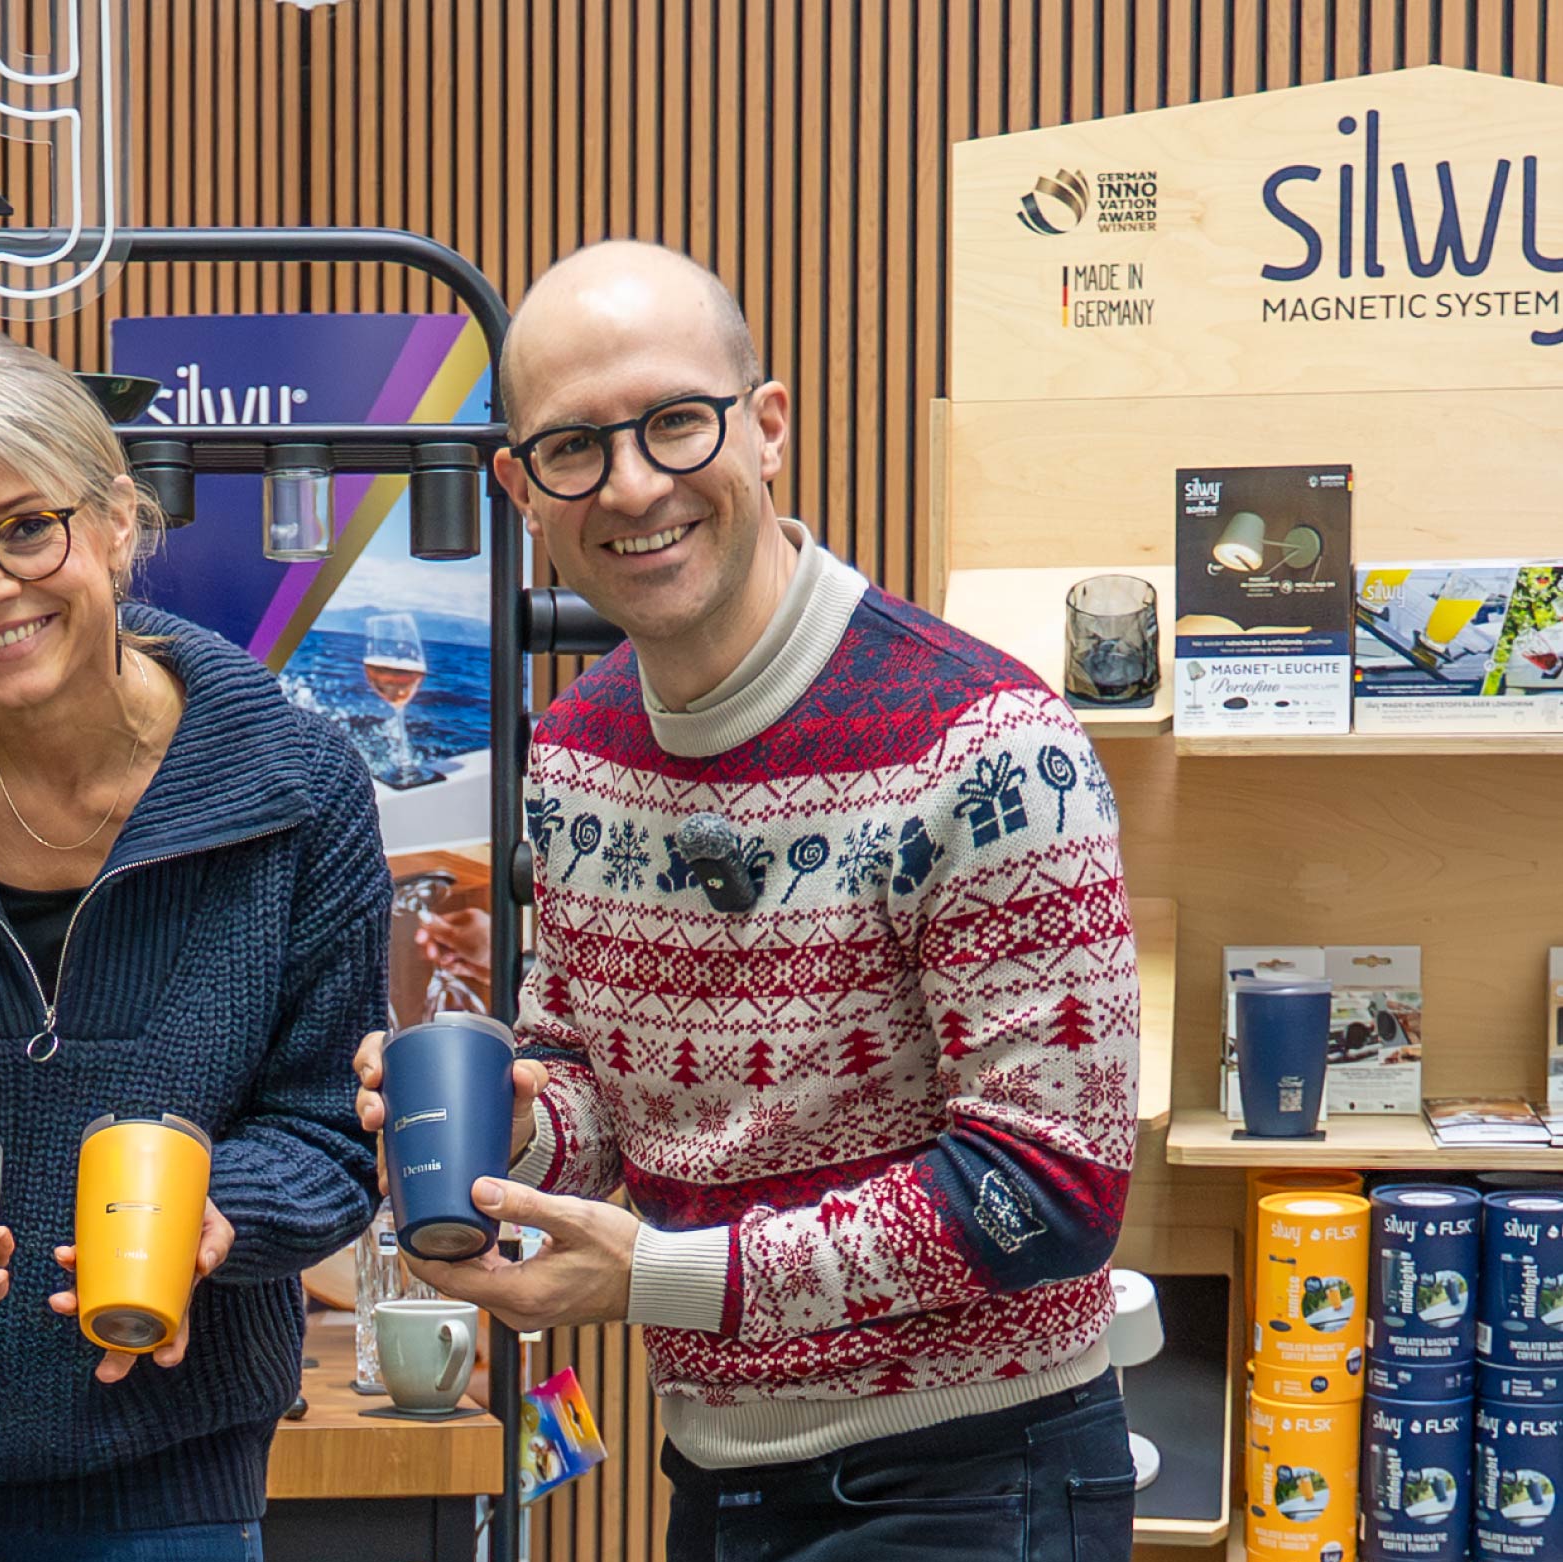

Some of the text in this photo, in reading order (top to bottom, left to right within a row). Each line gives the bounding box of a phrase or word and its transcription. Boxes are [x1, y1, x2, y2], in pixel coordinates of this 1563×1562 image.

[1097, 171, 1157, 183] GERMAN
[1097, 182, 1157, 199] INNO
[1097, 198, 1157, 210] VATION
[1097, 210, 1157, 223] AWARD
[1097, 222, 1157, 233] WINNER
[1073, 263, 1144, 292] MADE IN
[1073, 299, 1156, 329] GERMANY
[1261, 293, 1428, 323] MAGNETIC
[1184, 478, 1222, 503] silwy
[1366, 578, 1405, 608] silwy
[1210, 662, 1341, 675] MAGNET-LEUCHTE
[1208, 677, 1281, 696] Portofino
[403, 1158, 442, 1178] Dennis
[1384, 1213, 1472, 1243] silwy FLSK
[1503, 1217, 1539, 1246] silwy
[1399, 1259, 1417, 1314] midnight
[1521, 1264, 1540, 1318] midnight
[1295, 1418, 1333, 1433] FLSK
[1372, 1410, 1459, 1440] silwy FLSK
[1520, 1420, 1558, 1436] FLSK
[1386, 1456, 1404, 1510] midnight
